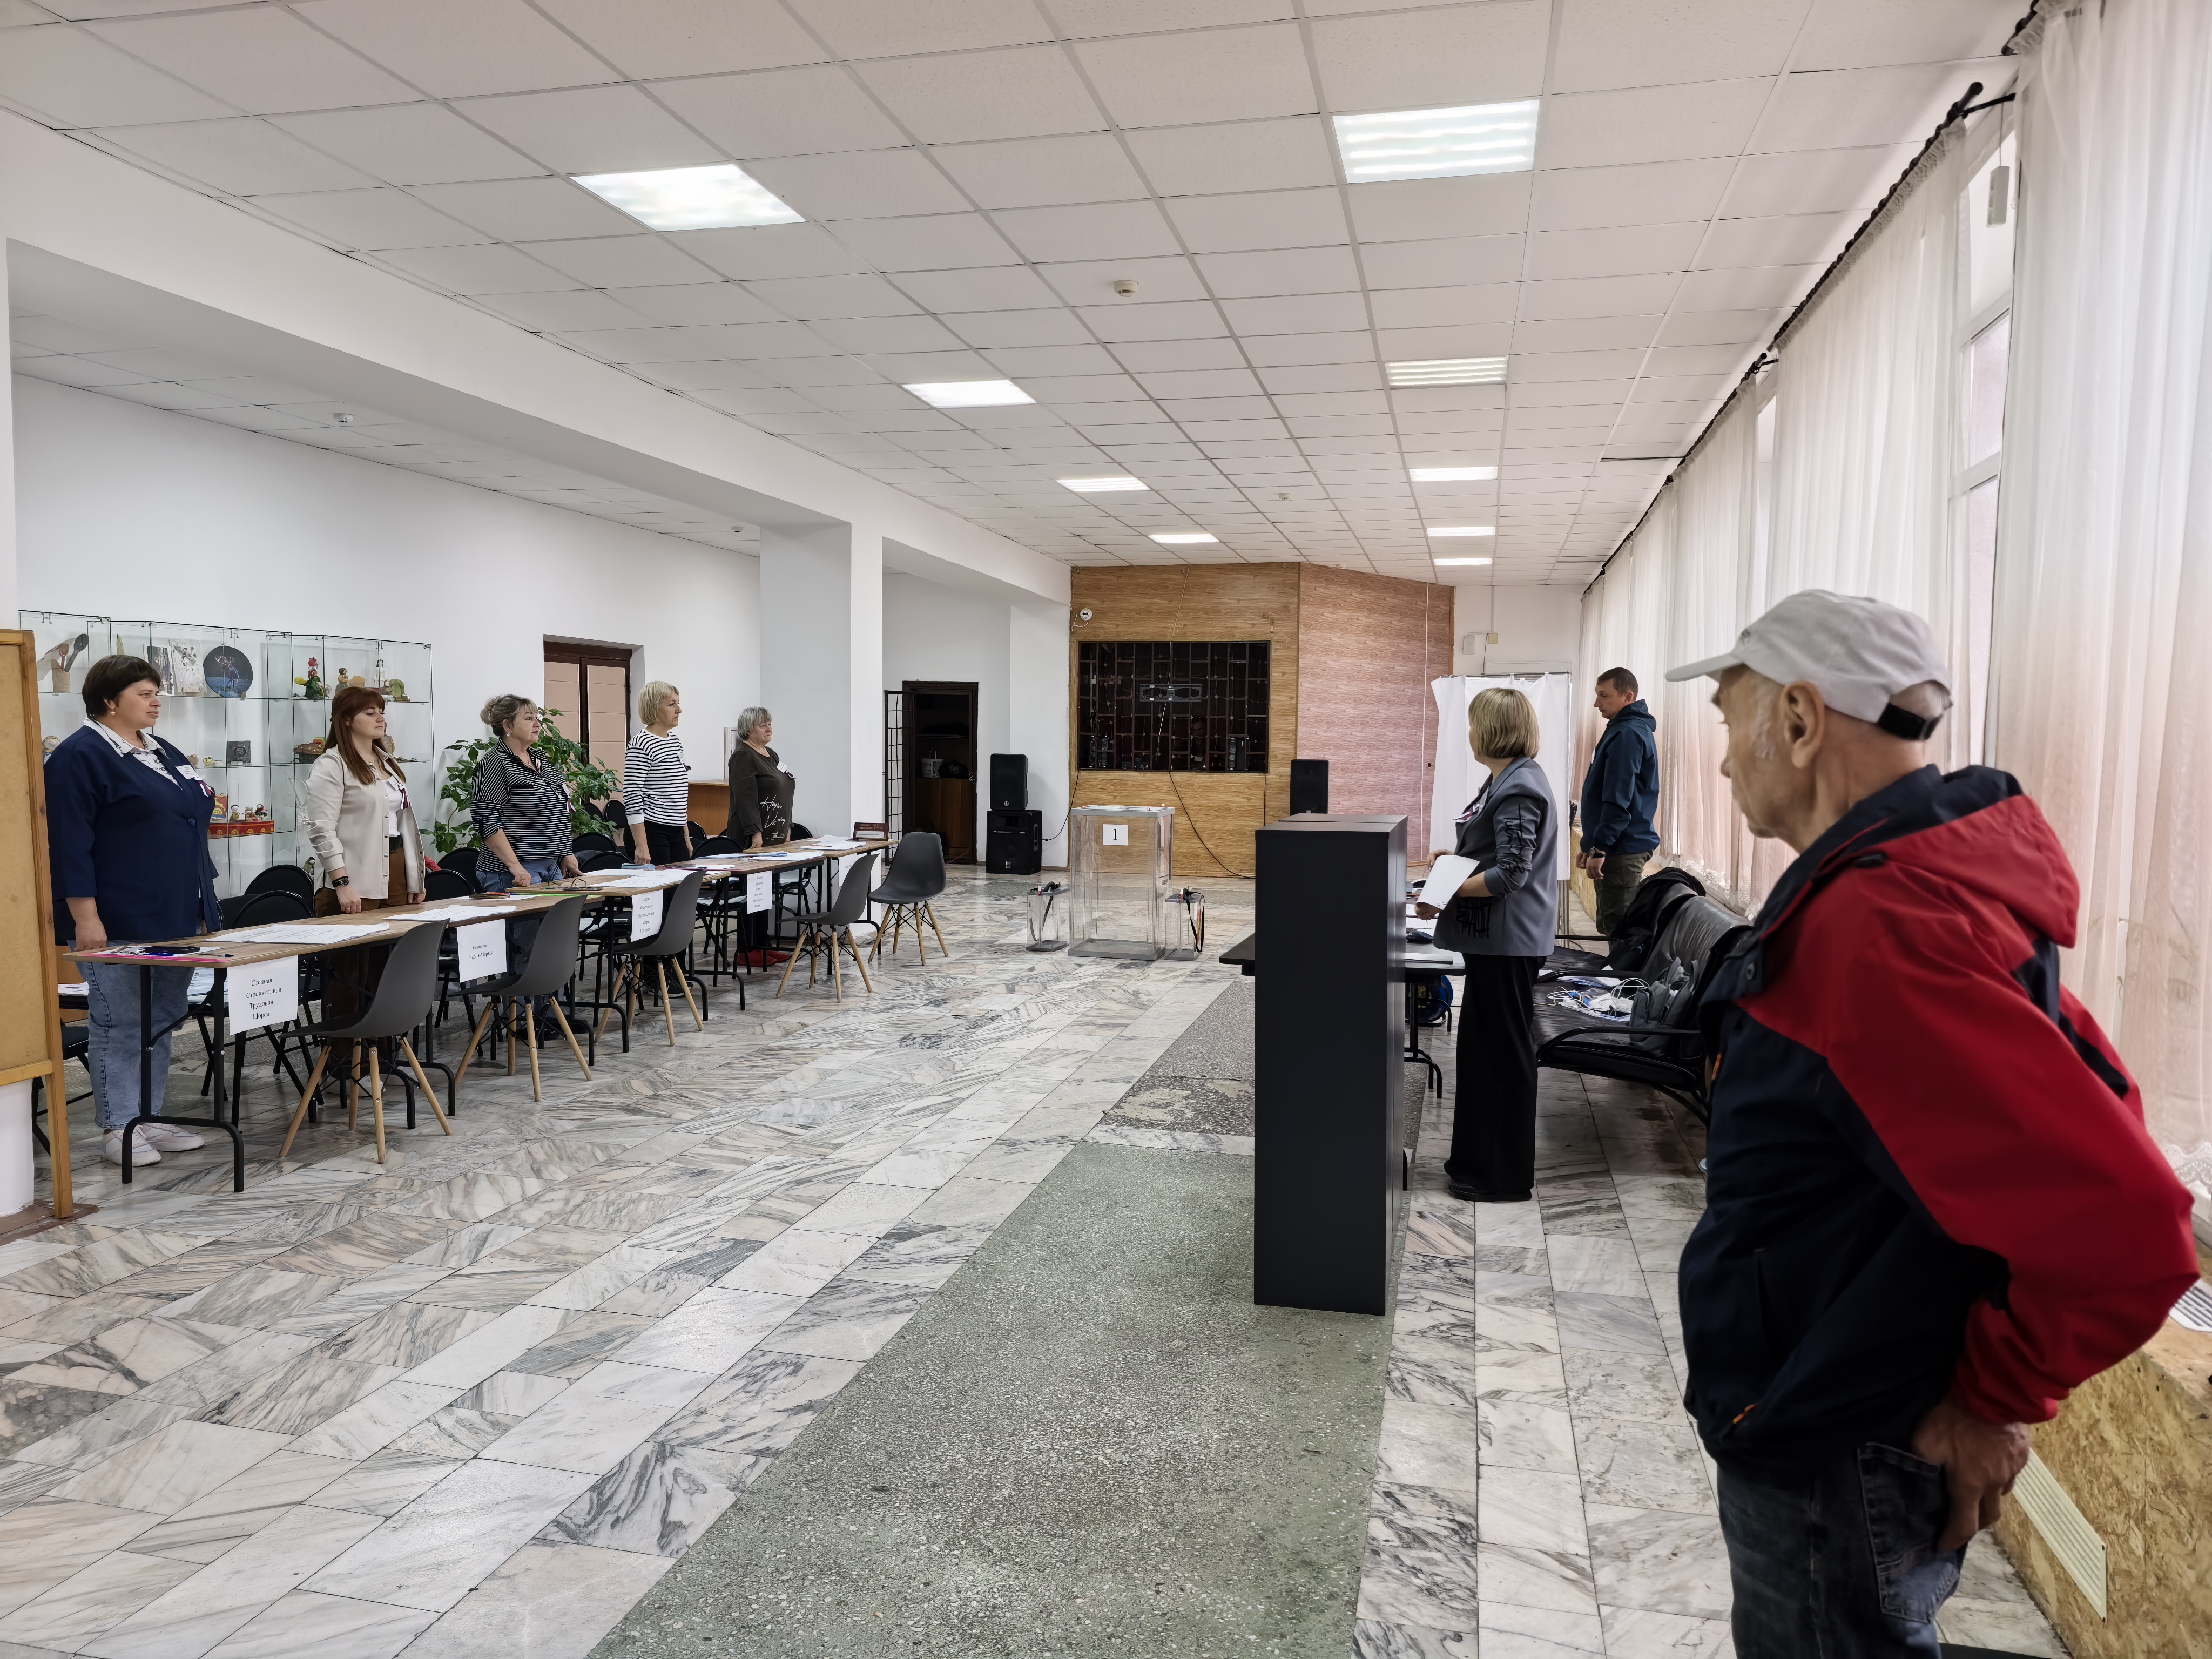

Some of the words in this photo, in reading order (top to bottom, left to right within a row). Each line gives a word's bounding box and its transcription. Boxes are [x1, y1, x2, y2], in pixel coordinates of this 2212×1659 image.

[1113, 828, 1117, 840] 1
[246, 988, 281, 999] Строительная
[249, 1000, 273, 1010] Трудовая
